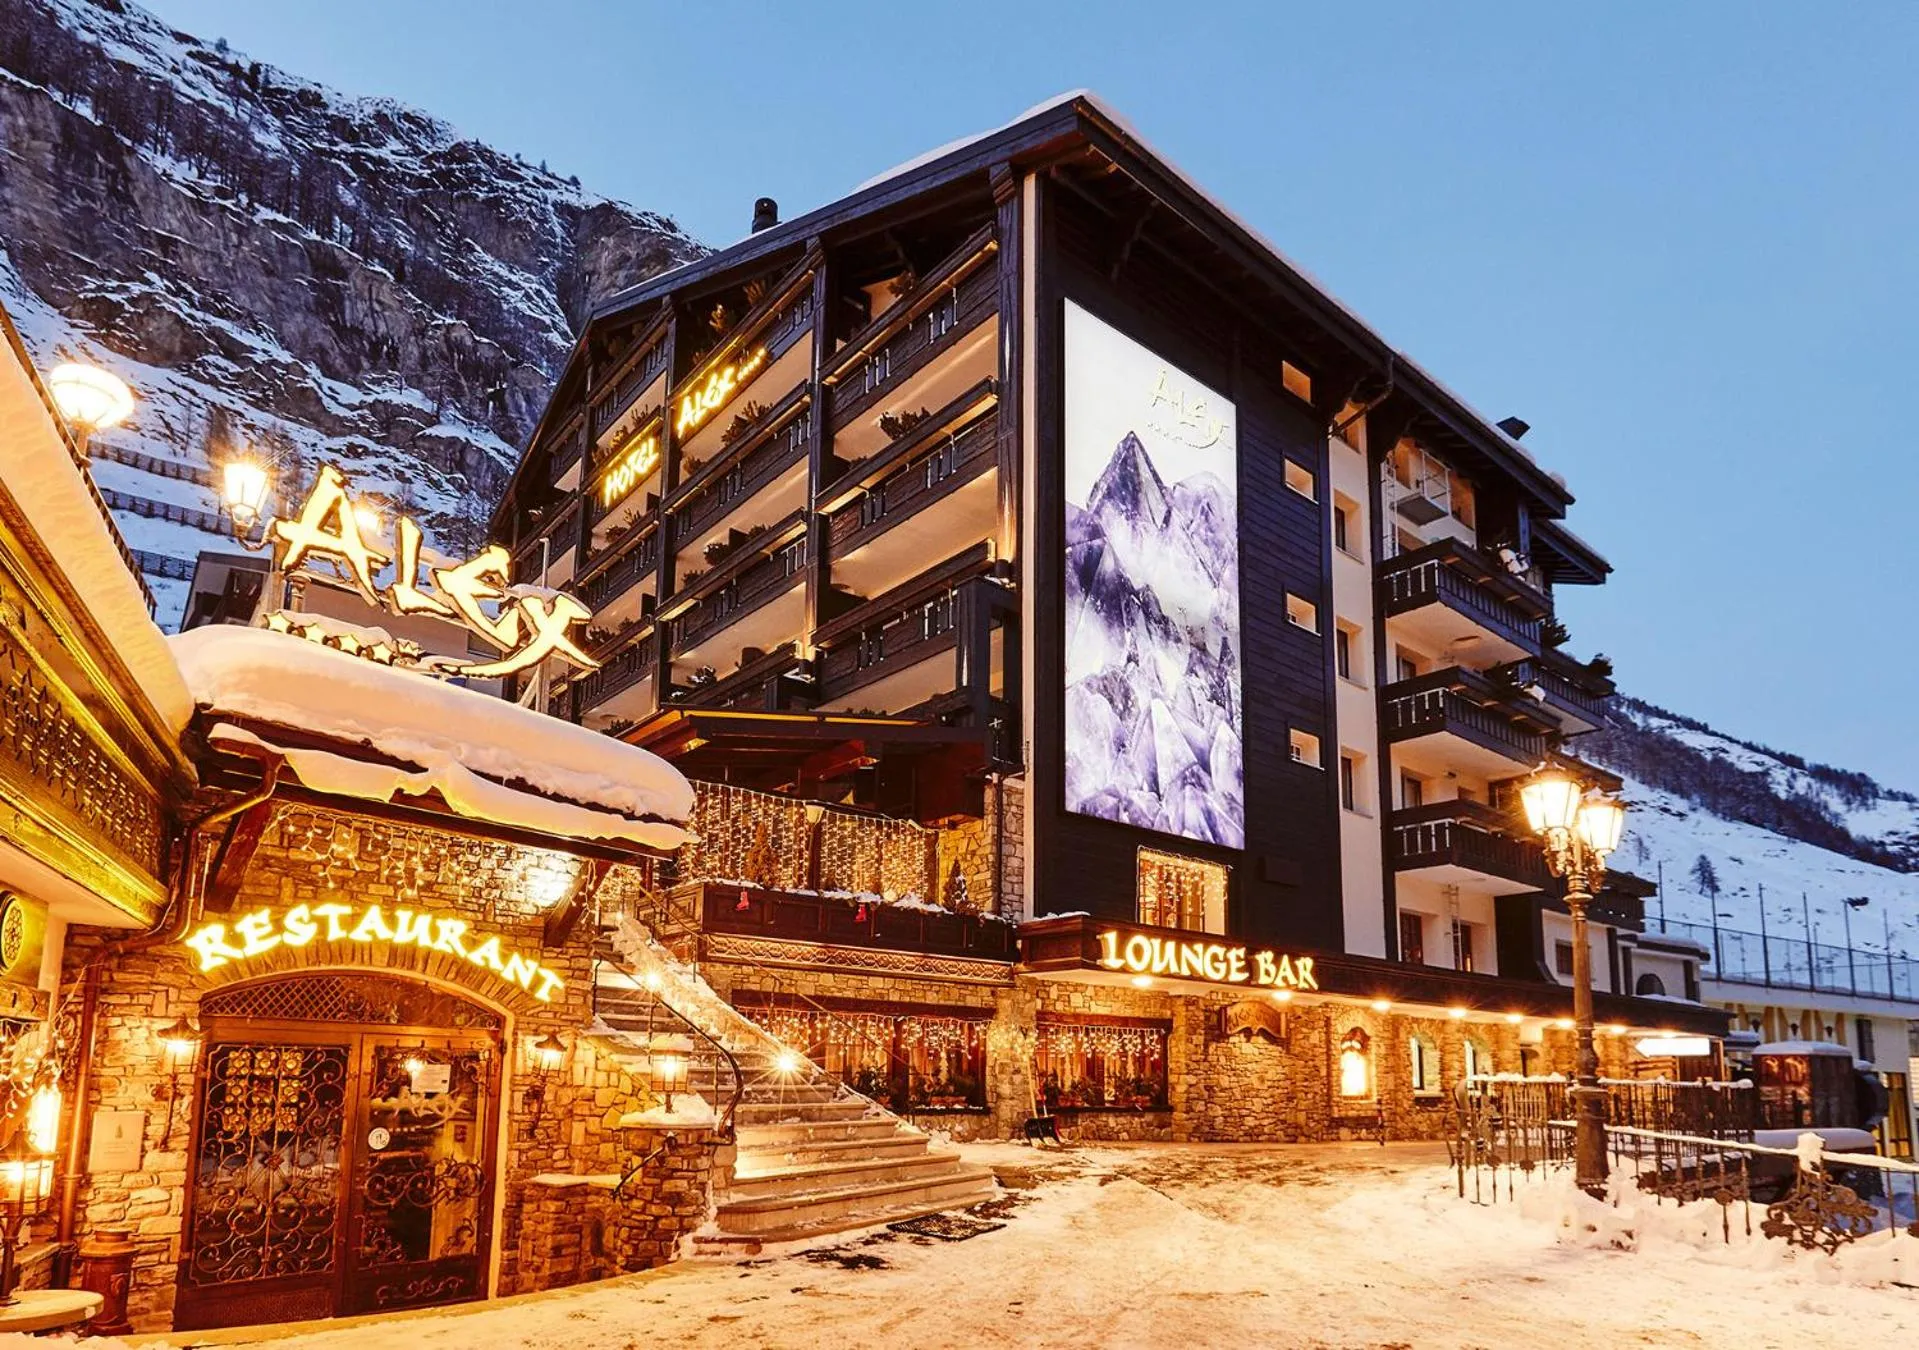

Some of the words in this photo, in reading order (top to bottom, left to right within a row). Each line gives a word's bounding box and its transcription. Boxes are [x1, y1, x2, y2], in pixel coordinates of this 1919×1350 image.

[604, 437, 659, 507] HOTEL
[270, 463, 601, 678] ALEX
[185, 903, 565, 1001] RESTAURANT
[1101, 930, 1249, 982] LOUNGE
[1255, 950, 1319, 990] BAR
